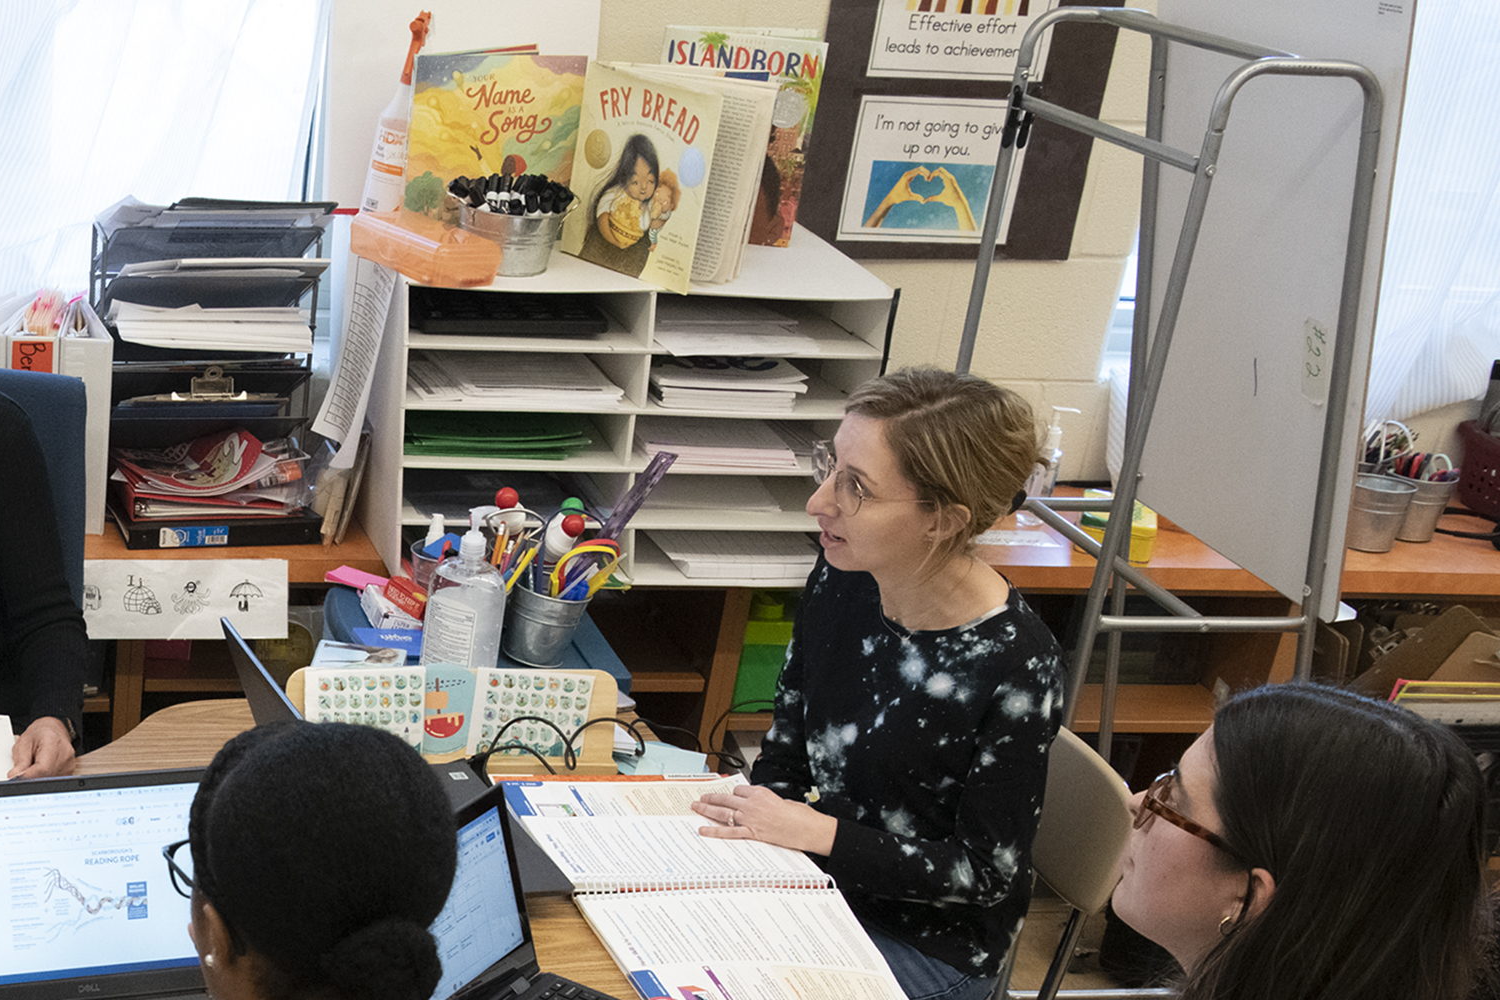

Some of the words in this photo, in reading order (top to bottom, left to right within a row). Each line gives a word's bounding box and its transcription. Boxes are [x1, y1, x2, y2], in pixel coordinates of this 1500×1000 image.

[908, 14, 972, 33] Effective
[977, 18, 1017, 35] effort
[885, 37, 921, 54] leads
[926, 42, 939, 55] to
[668, 39, 819, 79] ISLANDBORN
[473, 73, 495, 83] YOUR
[466, 81, 536, 111] Name
[600, 87, 632, 120] FRY
[641, 89, 700, 145] BREAD
[480, 110, 552, 145] Song
[875, 114, 894, 130] I'm
[898, 119, 921, 131] not
[923, 120, 960, 138] going
[965, 121, 979, 134] to
[982, 123, 1004, 140] giv
[903, 143, 920, 159] up
[924, 144, 940, 154] on
[944, 145, 971, 159] you.
[84, 856, 119, 866] READING
[119, 854, 139, 863] ROPE
[78, 983, 101, 993] DELL
